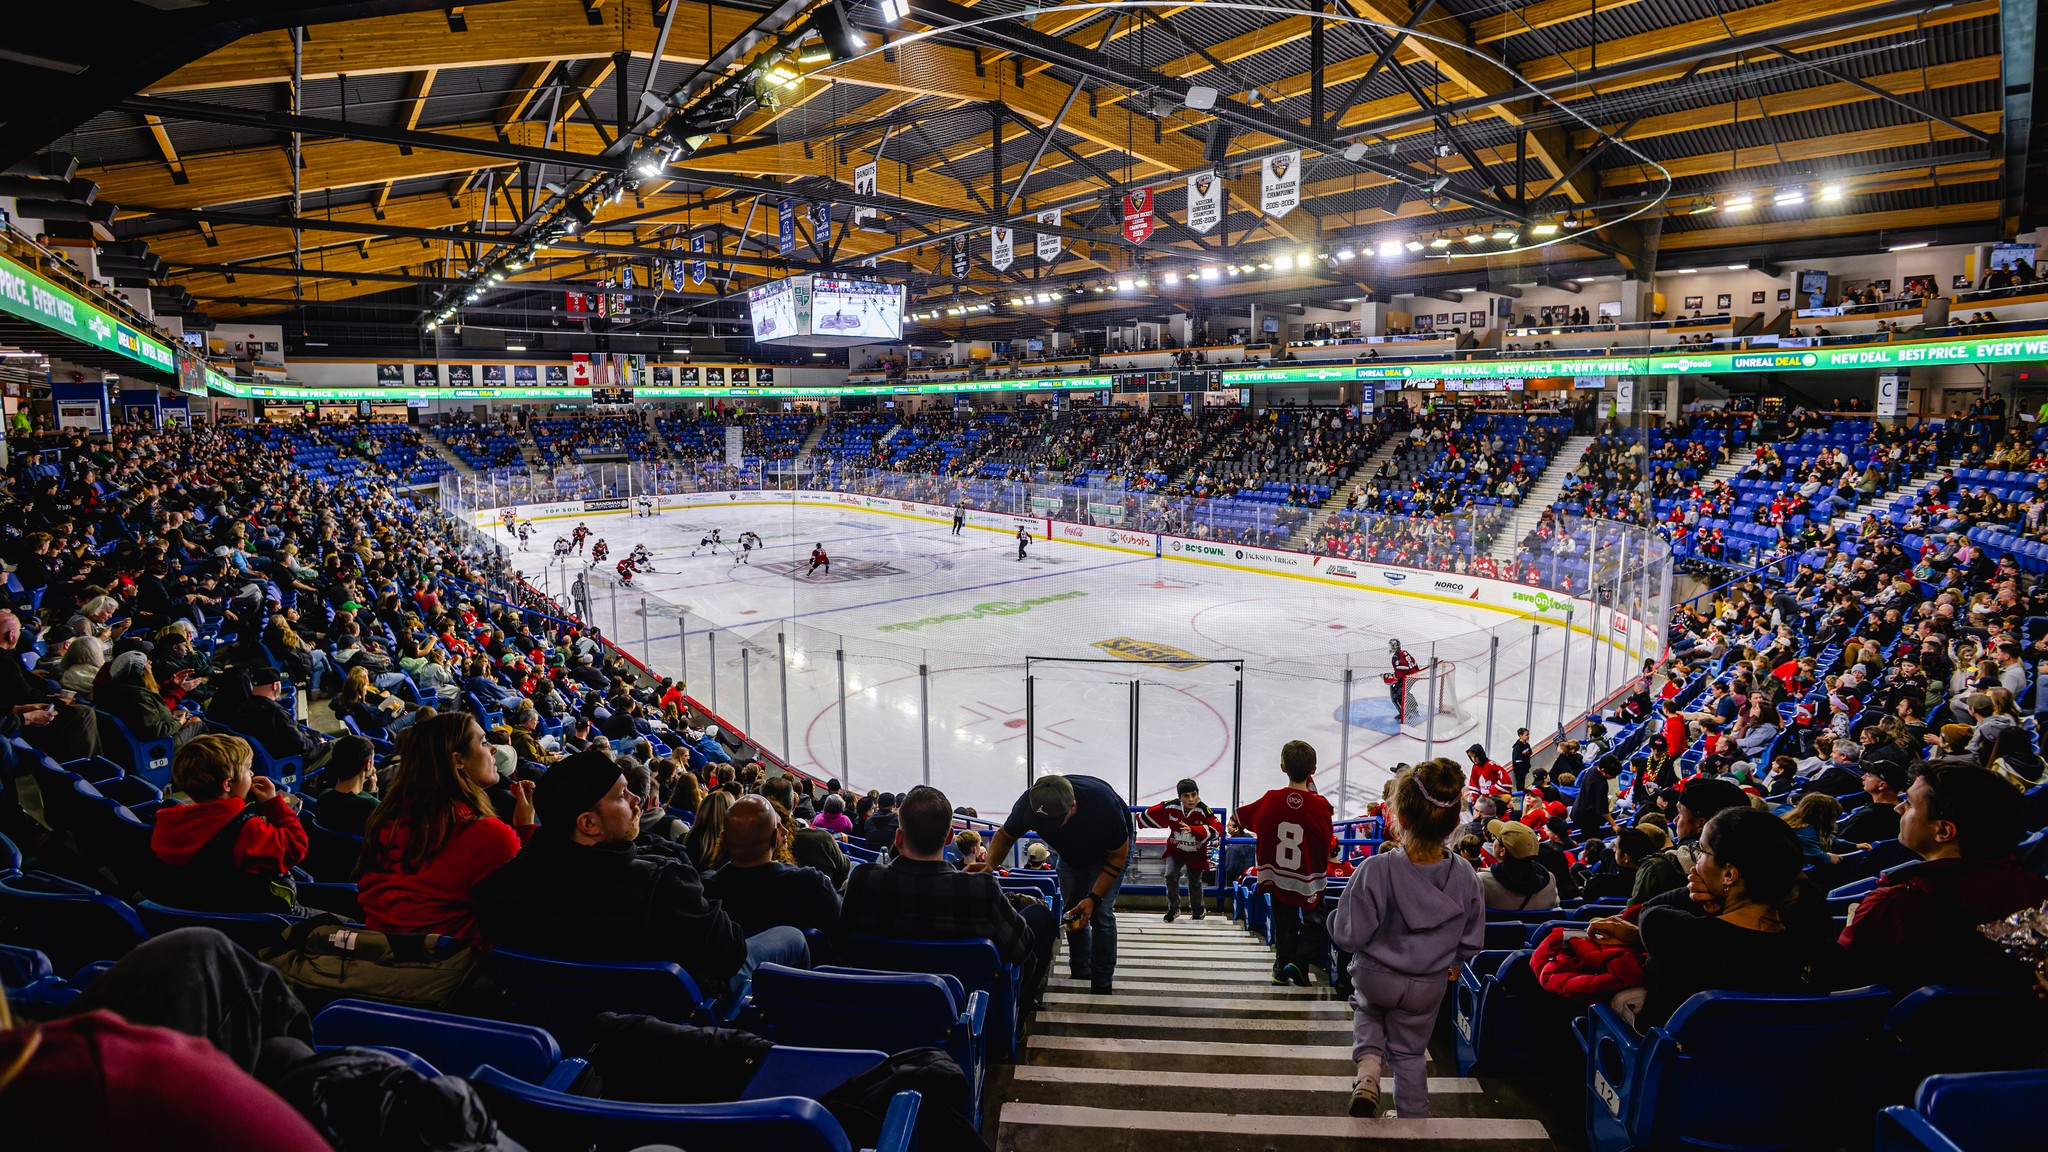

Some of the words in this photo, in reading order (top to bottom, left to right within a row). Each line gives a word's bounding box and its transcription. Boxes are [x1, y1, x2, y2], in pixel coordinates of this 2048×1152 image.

[856, 166, 875, 179] BANDITS
[858, 178, 874, 196] 14
[1275, 181, 1296, 190] DIVISION
[1266, 188, 1294, 199] CHAMPIONS
[1831, 353, 1858, 364] NEW
[1860, 351, 1891, 363] DEAL.
[1898, 349, 1926, 361] BEST
[1928, 346, 1969, 360] PRICE.
[1977, 342, 2023, 357] EVERY
[1441, 367, 1463, 375] NEW
[1464, 367, 1491, 375] DEAL.
[1497, 365, 1520, 374] BEST
[1522, 364, 1555, 373] PRICE.
[1561, 362, 1596, 373] EVERY
[1599, 362, 1633, 372] WEEK.
[1735, 358, 1774, 368] UNREAL
[1775, 357, 1801, 367] DEAL
[1244, 372, 1265, 381] EVERY
[1267, 372, 1288, 380] WEEK.
[1358, 369, 1384, 377] UNREAL
[1385, 369, 1402, 377] DEAL
[338, 390, 362, 398] EVERY
[1365, 390, 1372, 401] E
[1620, 386, 1630, 398] C
[1882, 382, 1892, 397] C
[1120, 533, 1150, 547] Kubota
[1185, 544, 1202, 554] BC'S
[1203, 547, 1226, 557] OWN.
[1434, 581, 1464, 591] NORCO
[1512, 590, 1534, 603] save
[1288, 796, 1302, 804] STOP
[1275, 821, 1304, 871] 8
[1461, 1018, 1468, 1034] 11
[1601, 1081, 1613, 1107] 12
